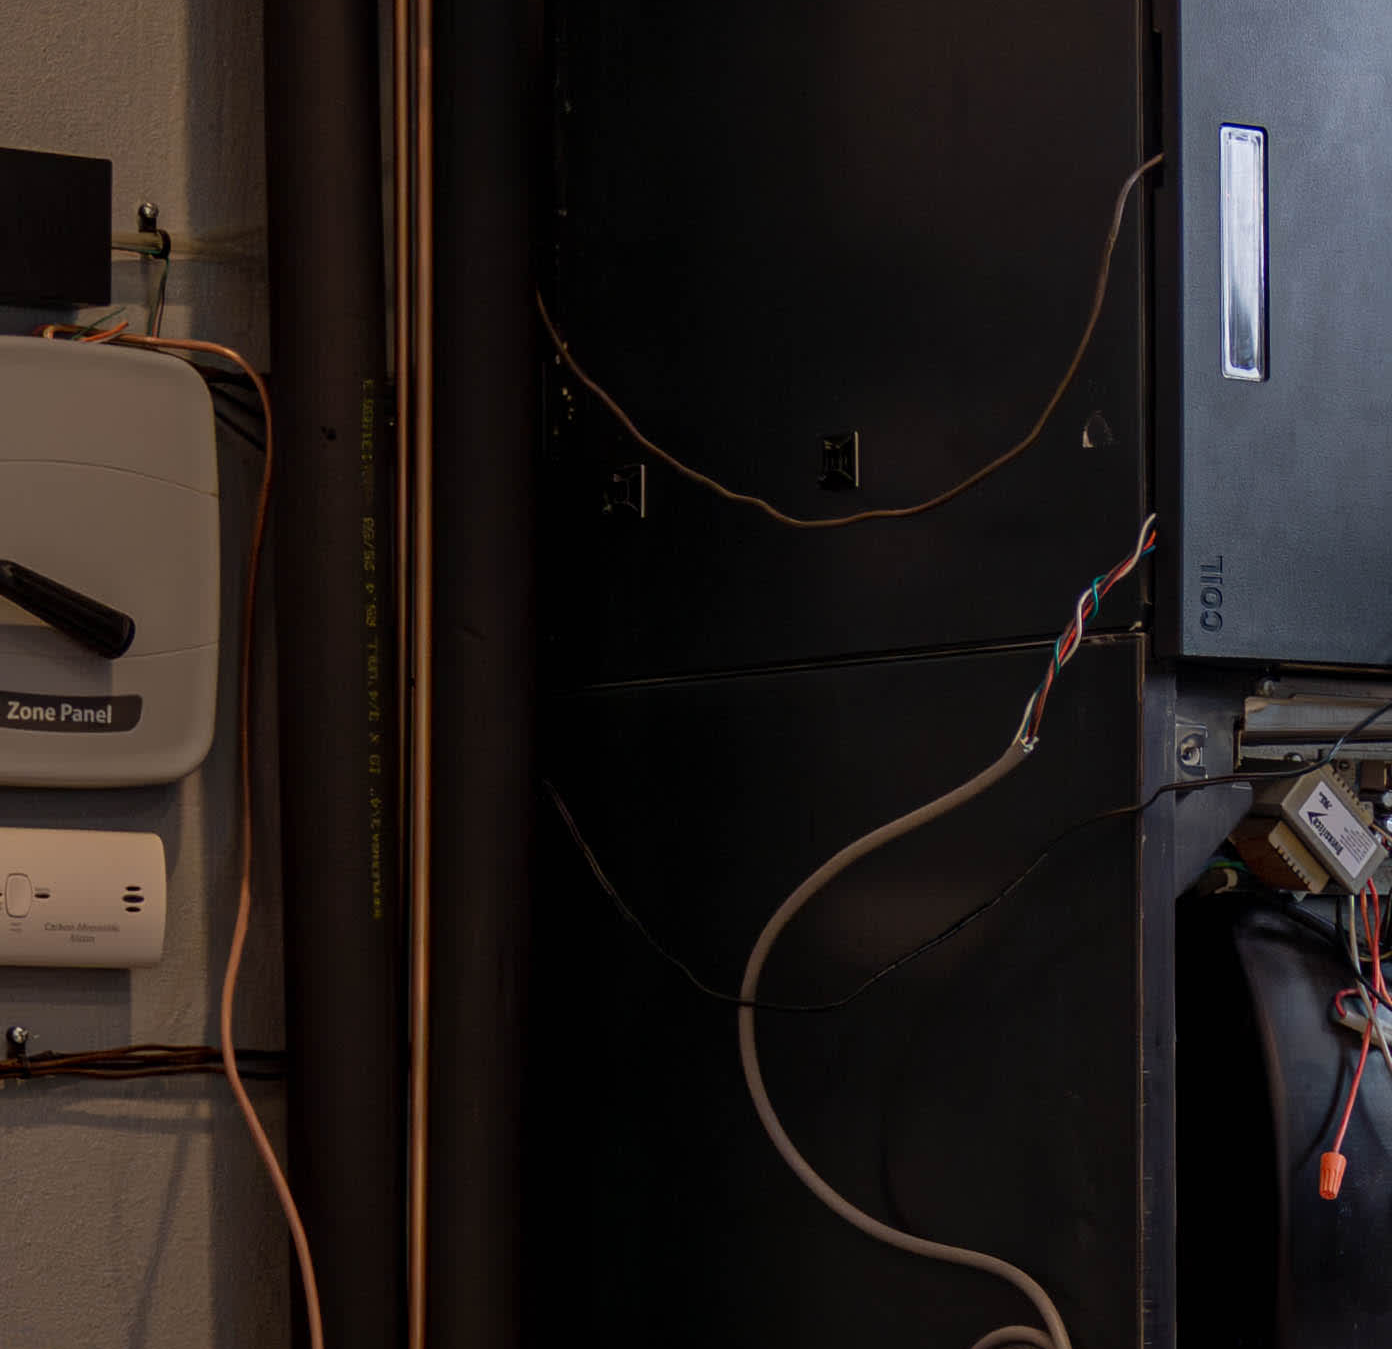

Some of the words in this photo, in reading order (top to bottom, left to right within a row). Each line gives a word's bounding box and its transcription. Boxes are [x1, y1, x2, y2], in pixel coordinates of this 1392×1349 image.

[1200, 555, 1223, 632] COIL
[7, 701, 56, 721] Zone
[60, 703, 113, 724] Panel
